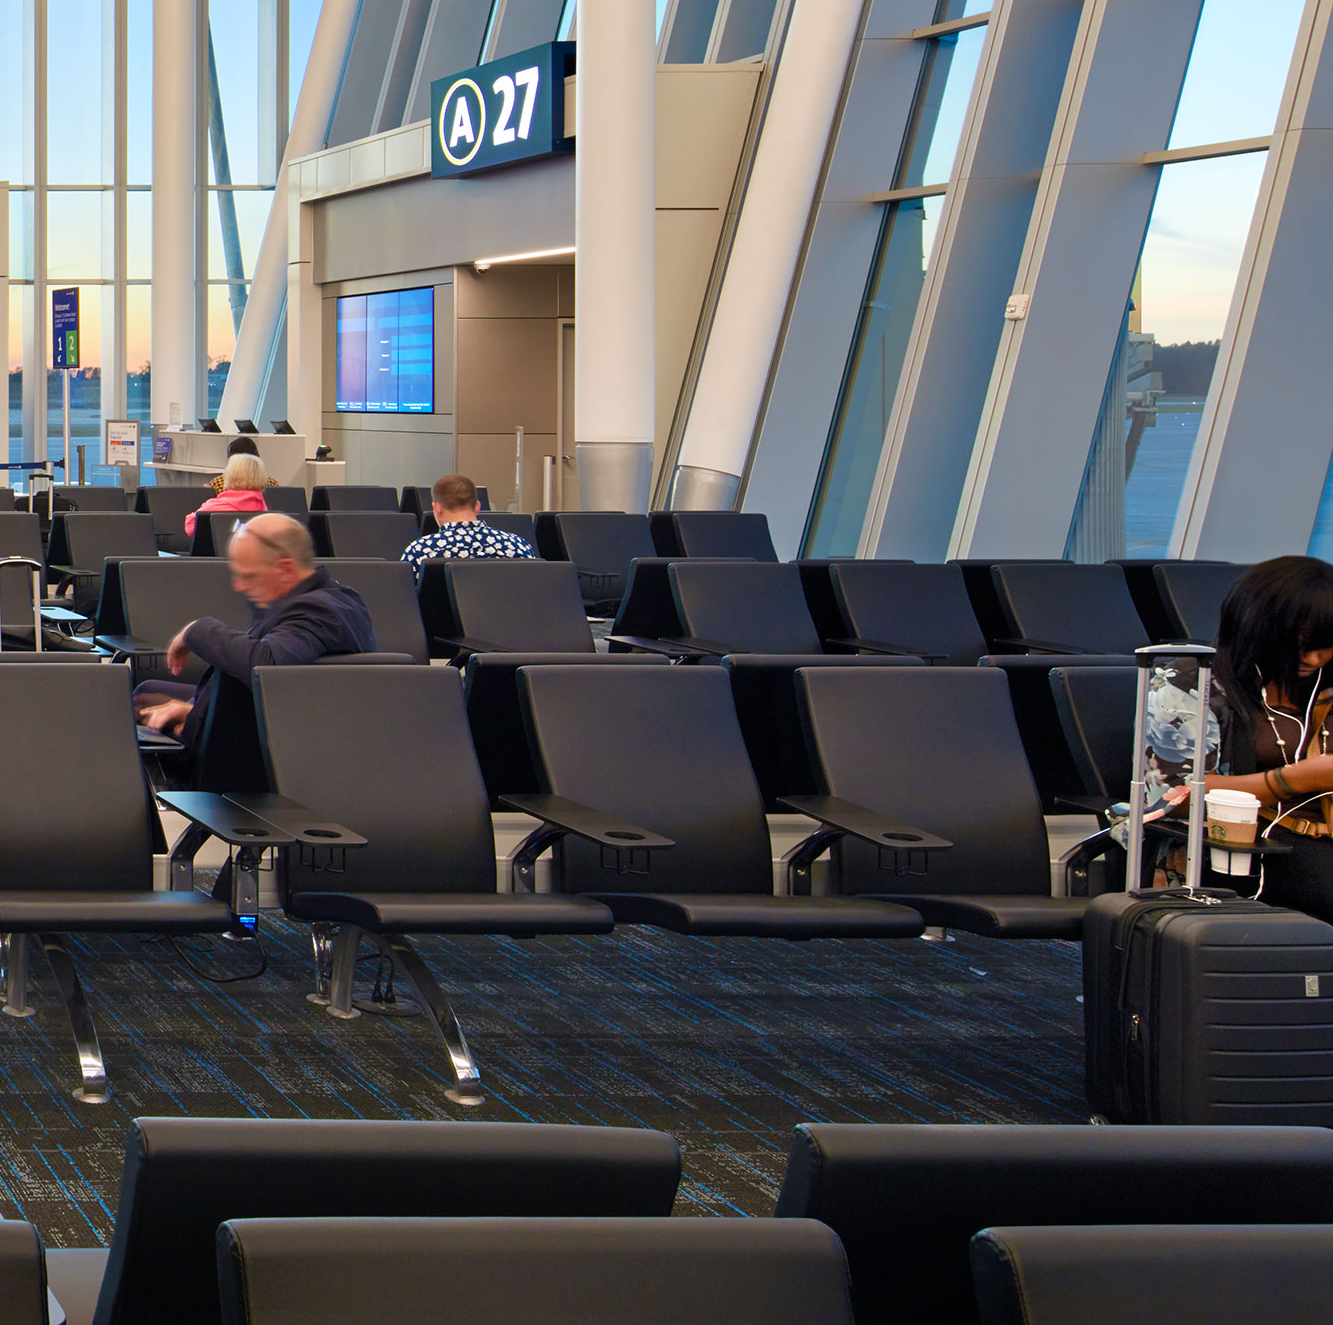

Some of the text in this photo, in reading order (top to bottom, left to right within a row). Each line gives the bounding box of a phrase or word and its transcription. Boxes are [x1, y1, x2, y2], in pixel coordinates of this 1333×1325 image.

[449, 65, 539, 148] A 27
[57, 335, 75, 352] 1 2
